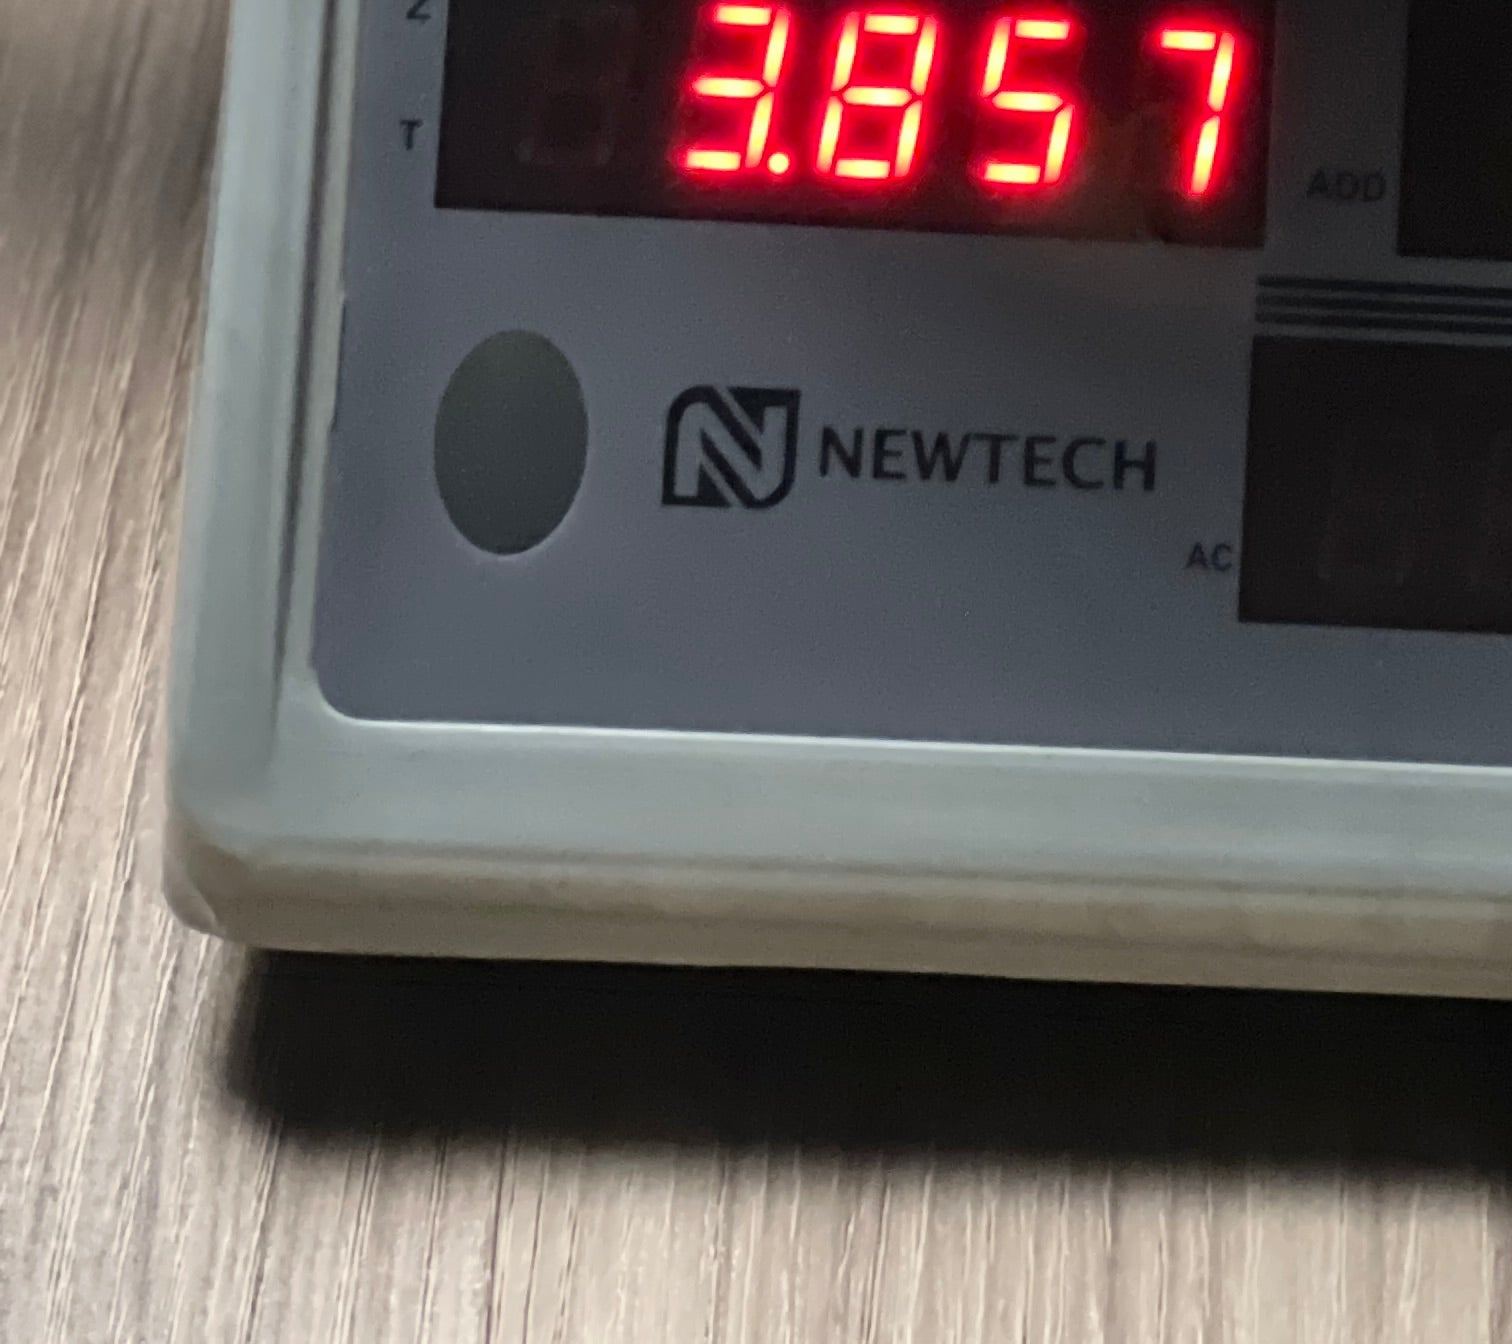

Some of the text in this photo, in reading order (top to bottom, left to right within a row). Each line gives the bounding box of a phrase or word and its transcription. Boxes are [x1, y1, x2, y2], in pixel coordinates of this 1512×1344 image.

[682, 2, 1238, 196] 3.857
[401, 120, 423, 151] T
[1307, 169, 1386, 203] ADD
[819, 426, 1158, 492] NEWTECH
[1185, 542, 1234, 572] AC
